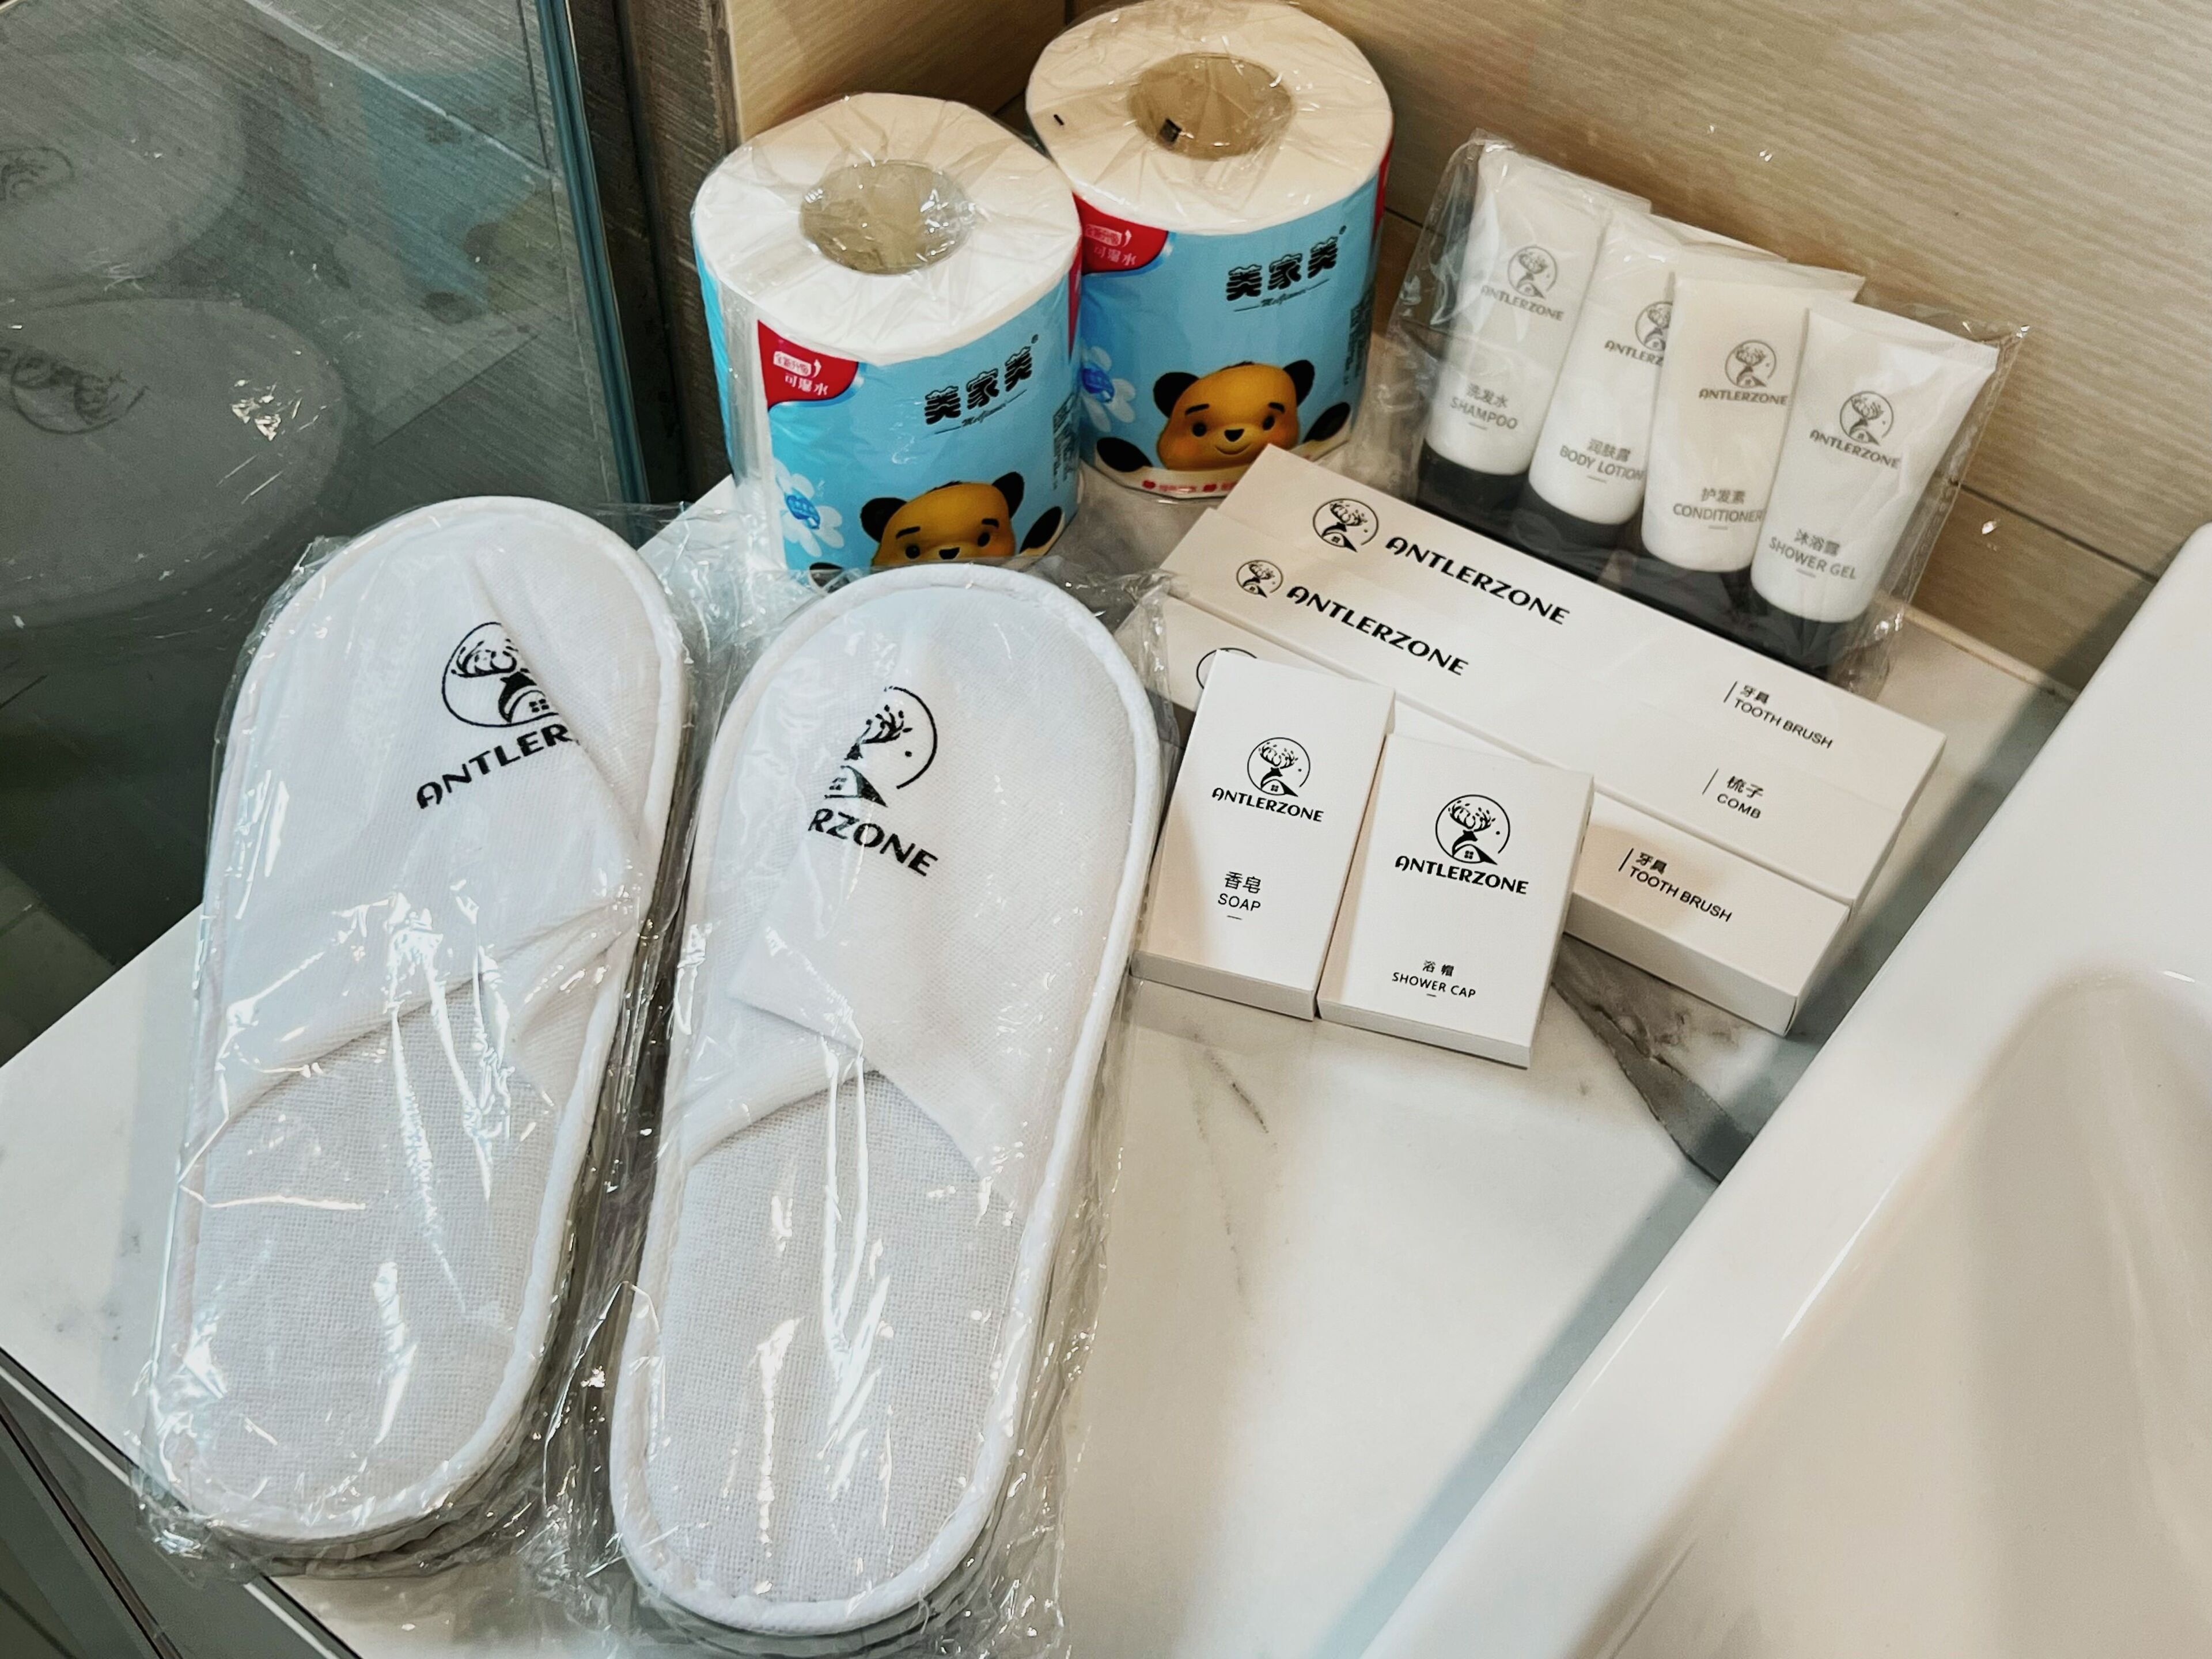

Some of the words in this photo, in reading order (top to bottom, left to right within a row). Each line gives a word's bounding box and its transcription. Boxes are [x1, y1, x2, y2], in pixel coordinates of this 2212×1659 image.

[1480, 285, 1565, 321] ANTLERZONE
[1466, 382, 1509, 408] 洗发水
[1698, 388, 1788, 406] ANTLERZONE
[1450, 396, 1518, 430] SHAMPOO
[1559, 445, 1596, 469] BODY
[1597, 461, 1647, 480] LOTION
[1809, 429, 1901, 469] ANTLERZONE
[1673, 503, 1767, 523] CONDITIONER
[1701, 487, 1746, 505] 护发素
[1769, 536, 1828, 573] SHOWER
[1830, 562, 1857, 579] GEL
[1385, 536, 1571, 626] ANTLERZONE
[1286, 586, 1469, 677] ANTLERZONE
[1740, 684, 1770, 704] 牙具
[1734, 697, 1782, 727] TOOTH
[1783, 719, 1834, 749] BRUSH
[415, 724, 581, 809] ANTLER
[1726, 775, 1764, 800] 梳子
[1211, 787, 1324, 823] ANTLERZONE
[1717, 793, 1762, 820] COMB
[1394, 855, 1529, 895] ANTLERZONE
[1635, 851, 1667, 876] 牙具
[1224, 870, 1262, 895] 香皂
[1629, 865, 1679, 898] TOOTH
[1679, 891, 1733, 923] BRUSH
[1217, 892, 1262, 913] SOAP
[1392, 972, 1447, 993] SHOWER
[1450, 984, 1476, 998] CAP
